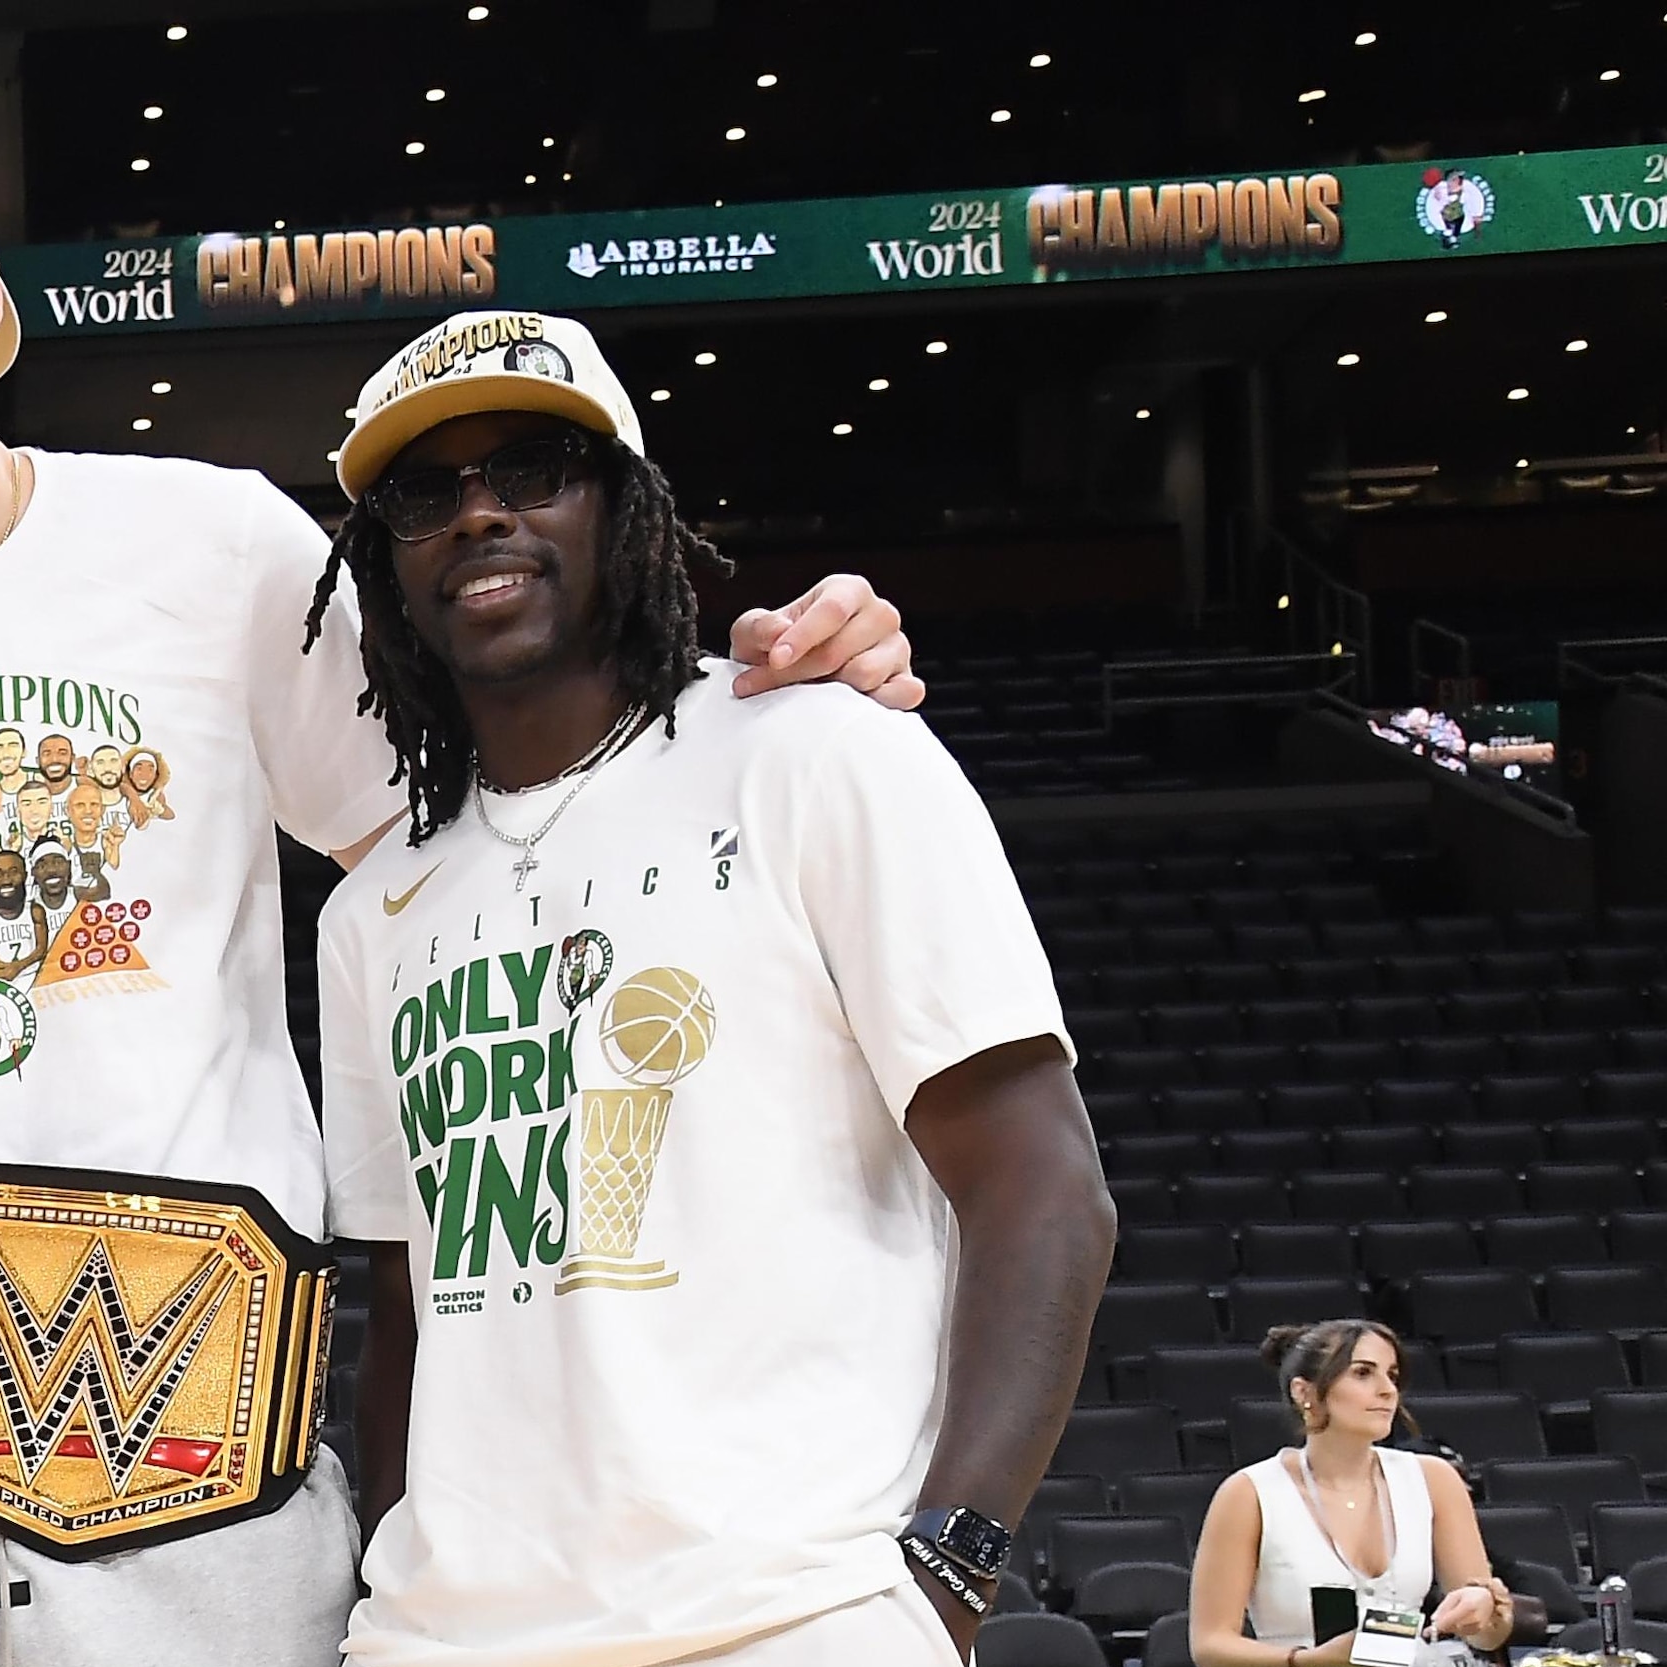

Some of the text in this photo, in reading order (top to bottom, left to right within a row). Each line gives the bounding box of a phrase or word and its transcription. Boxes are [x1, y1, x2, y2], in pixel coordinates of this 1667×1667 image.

[929, 201, 1001, 234] 2024
[1026, 174, 1342, 267] CHAMPIONS
[104, 248, 172, 280] 2024
[197, 224, 495, 308] CHAMPIONS
[599, 234, 775, 262] ARBELLA
[619, 255, 753, 276] INSURANCE
[867, 231, 1003, 281] World
[43, 278, 175, 326] World
[6, 987, 36, 1047] CELTICS
[391, 942, 555, 1077] ONLY
[432, 1289, 486, 1304] BOSTON
[435, 1301, 484, 1316] CELTICS
[70, 1486, 205, 1531] CHAMPION
[962, 1588, 987, 1613] With
